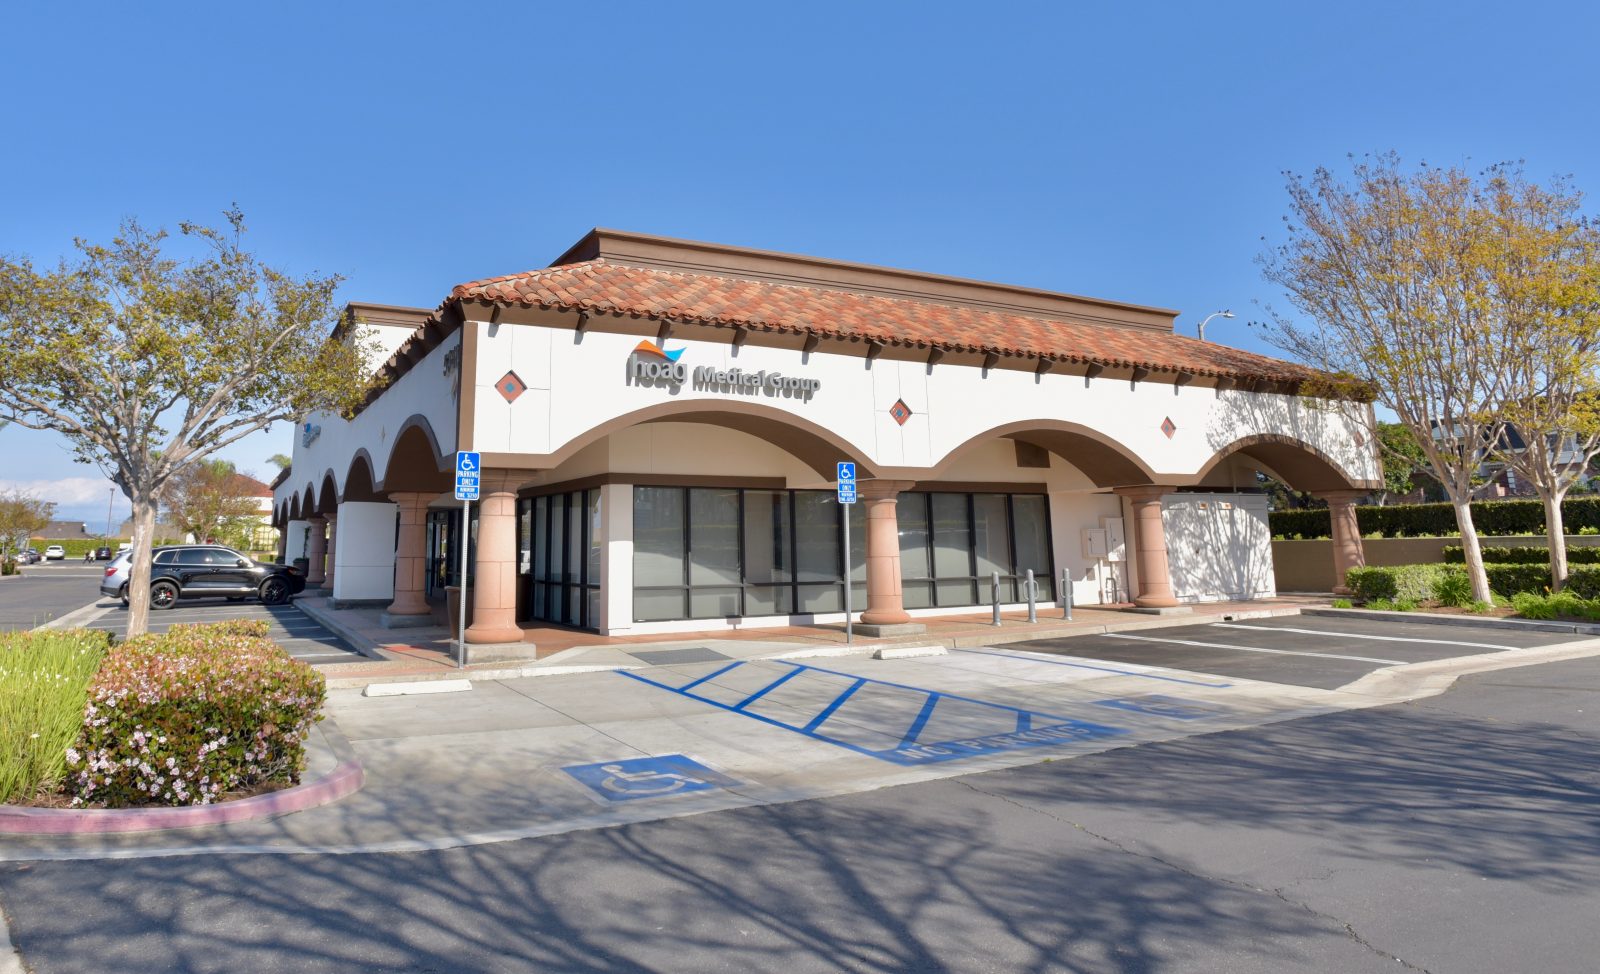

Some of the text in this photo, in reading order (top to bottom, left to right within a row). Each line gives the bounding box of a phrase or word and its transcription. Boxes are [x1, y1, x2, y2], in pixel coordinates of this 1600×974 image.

[633, 353, 821, 392] hoag Medical Group
[458, 470, 479, 478] PARKING
[462, 478, 475, 486] ONLY
[896, 726, 1091, 759] NO PARKING
